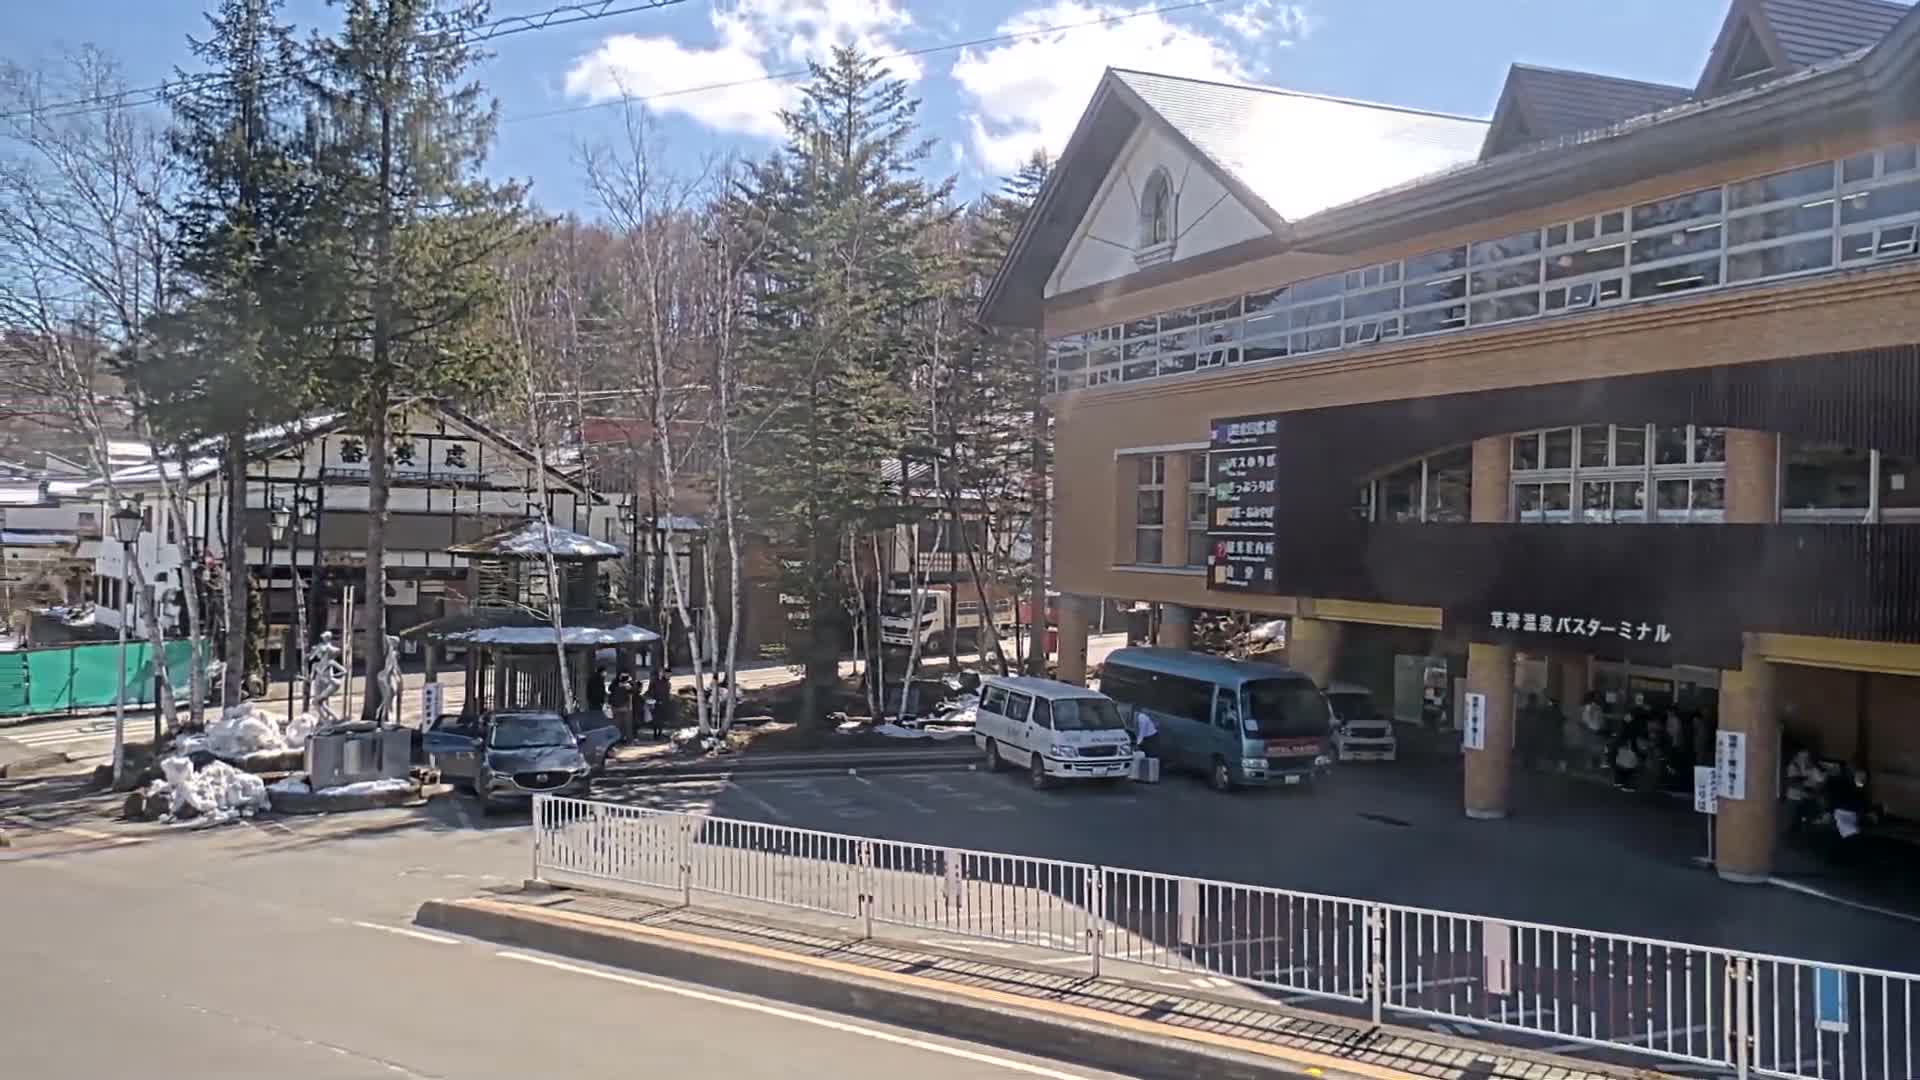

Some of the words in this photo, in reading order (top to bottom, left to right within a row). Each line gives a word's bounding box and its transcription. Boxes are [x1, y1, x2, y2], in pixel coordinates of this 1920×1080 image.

[1490, 611, 1671, 643] 草津温泉バスターミナル
